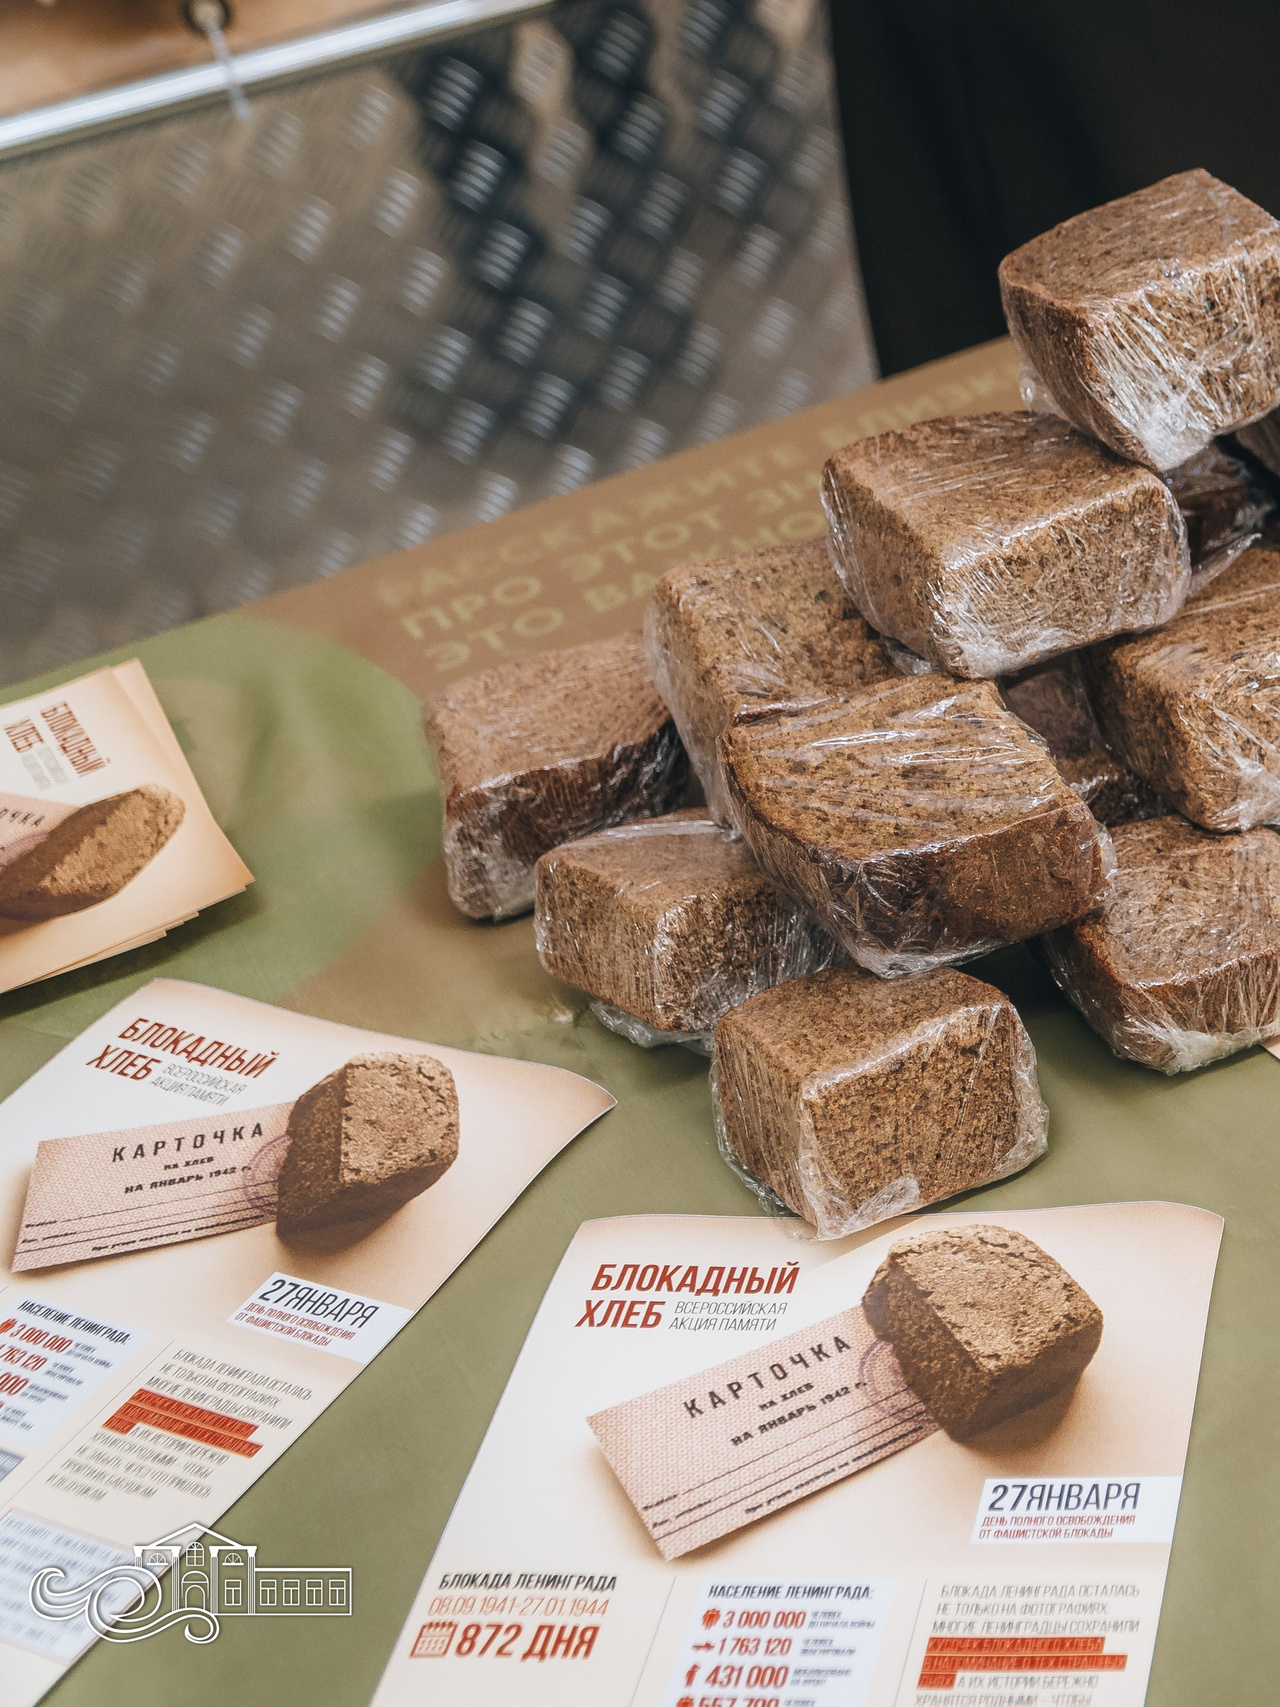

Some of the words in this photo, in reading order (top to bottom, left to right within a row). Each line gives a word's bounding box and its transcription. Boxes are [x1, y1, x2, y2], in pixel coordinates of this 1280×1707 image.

[400, 576, 542, 638] ПРО
[560, 504, 724, 583] ЭТОТ
[424, 606, 565, 672] ЭТО
[83, 1044, 164, 1082] ХЛЕБ
[115, 1017, 279, 1079] БЛОКАДНЫЙ
[147, 1075, 190, 1095] АКЦИЯ
[180, 1085, 232, 1107] ПАМЯТИ
[160, 1063, 250, 1095] ВСЕРОССИЙСКАЯ
[112, 1123, 263, 1162] КАРТОЧКА
[123, 1184, 144, 1193] НА
[149, 1173, 204, 1188] ЯНВАРЬ
[208, 1167, 236, 1178] 1942
[591, 1261, 800, 1297] БЛОКАДНЫЙ
[243, 1302, 268, 1315] ДЕНЬ
[262, 1307, 300, 1324] ПОЛНОГО
[294, 1316, 356, 1342] ОСВОБОЖДЕНИЯ
[575, 1300, 666, 1328] ХЛЕБ
[674, 1301, 788, 1315] ВСЕРОССИЙСКАЯ
[233, 1312, 248, 1321] ОТ
[243, 1314, 297, 1336] ФАШИСТСКОЙ
[291, 1329, 332, 1347] БЛОКАДЫ
[668, 1317, 717, 1332] АКЦИЯ
[718, 1318, 776, 1331] ПАМЯТИ
[684, 1336, 851, 1418] КАРТОЧКА
[730, 1432, 754, 1446] НА
[758, 1403, 816, 1434] ЯНВАРЬ
[820, 1387, 850, 1405] 1942
[979, 1530, 991, 1539] ОТ
[994, 1527, 1061, 1539] ФАШИСТСКОЙ
[1064, 1528, 1113, 1539] БЛОКАДЫ
[982, 1516, 1007, 1527] ДЕНЬ
[1010, 1516, 1054, 1526] ПОЛНОГО
[1056, 1515, 1136, 1526] ОСВОБОЖДЕНИЯ
[438, 1573, 512, 1590] БЛОКАДА
[513, 1574, 618, 1592] ЛЕНИНГРАДА
[708, 1585, 784, 1599] НАСЕЛЕНИЕ
[784, 1585, 874, 1601] ЛЕНИНГРАДА:
[941, 1585, 997, 1599] БЛОКАДА
[1000, 1585, 1074, 1598] ЛЕНИНГРАДА
[1079, 1584, 1139, 1598] ОСТАЛАСЬ
[427, 1595, 610, 1618] 08.09.1941-27.01.1944
[722, 1611, 735, 1628] 3
[738, 1610, 771, 1629] 000
[773, 1610, 807, 1629] 000
[454, 1623, 523, 1658] 872
[519, 1624, 601, 1663] ДНЯ
[731, 1637, 761, 1656] 763
[763, 1637, 793, 1656] 120
[705, 1665, 743, 1688] 431
[745, 1665, 790, 1689] 000
